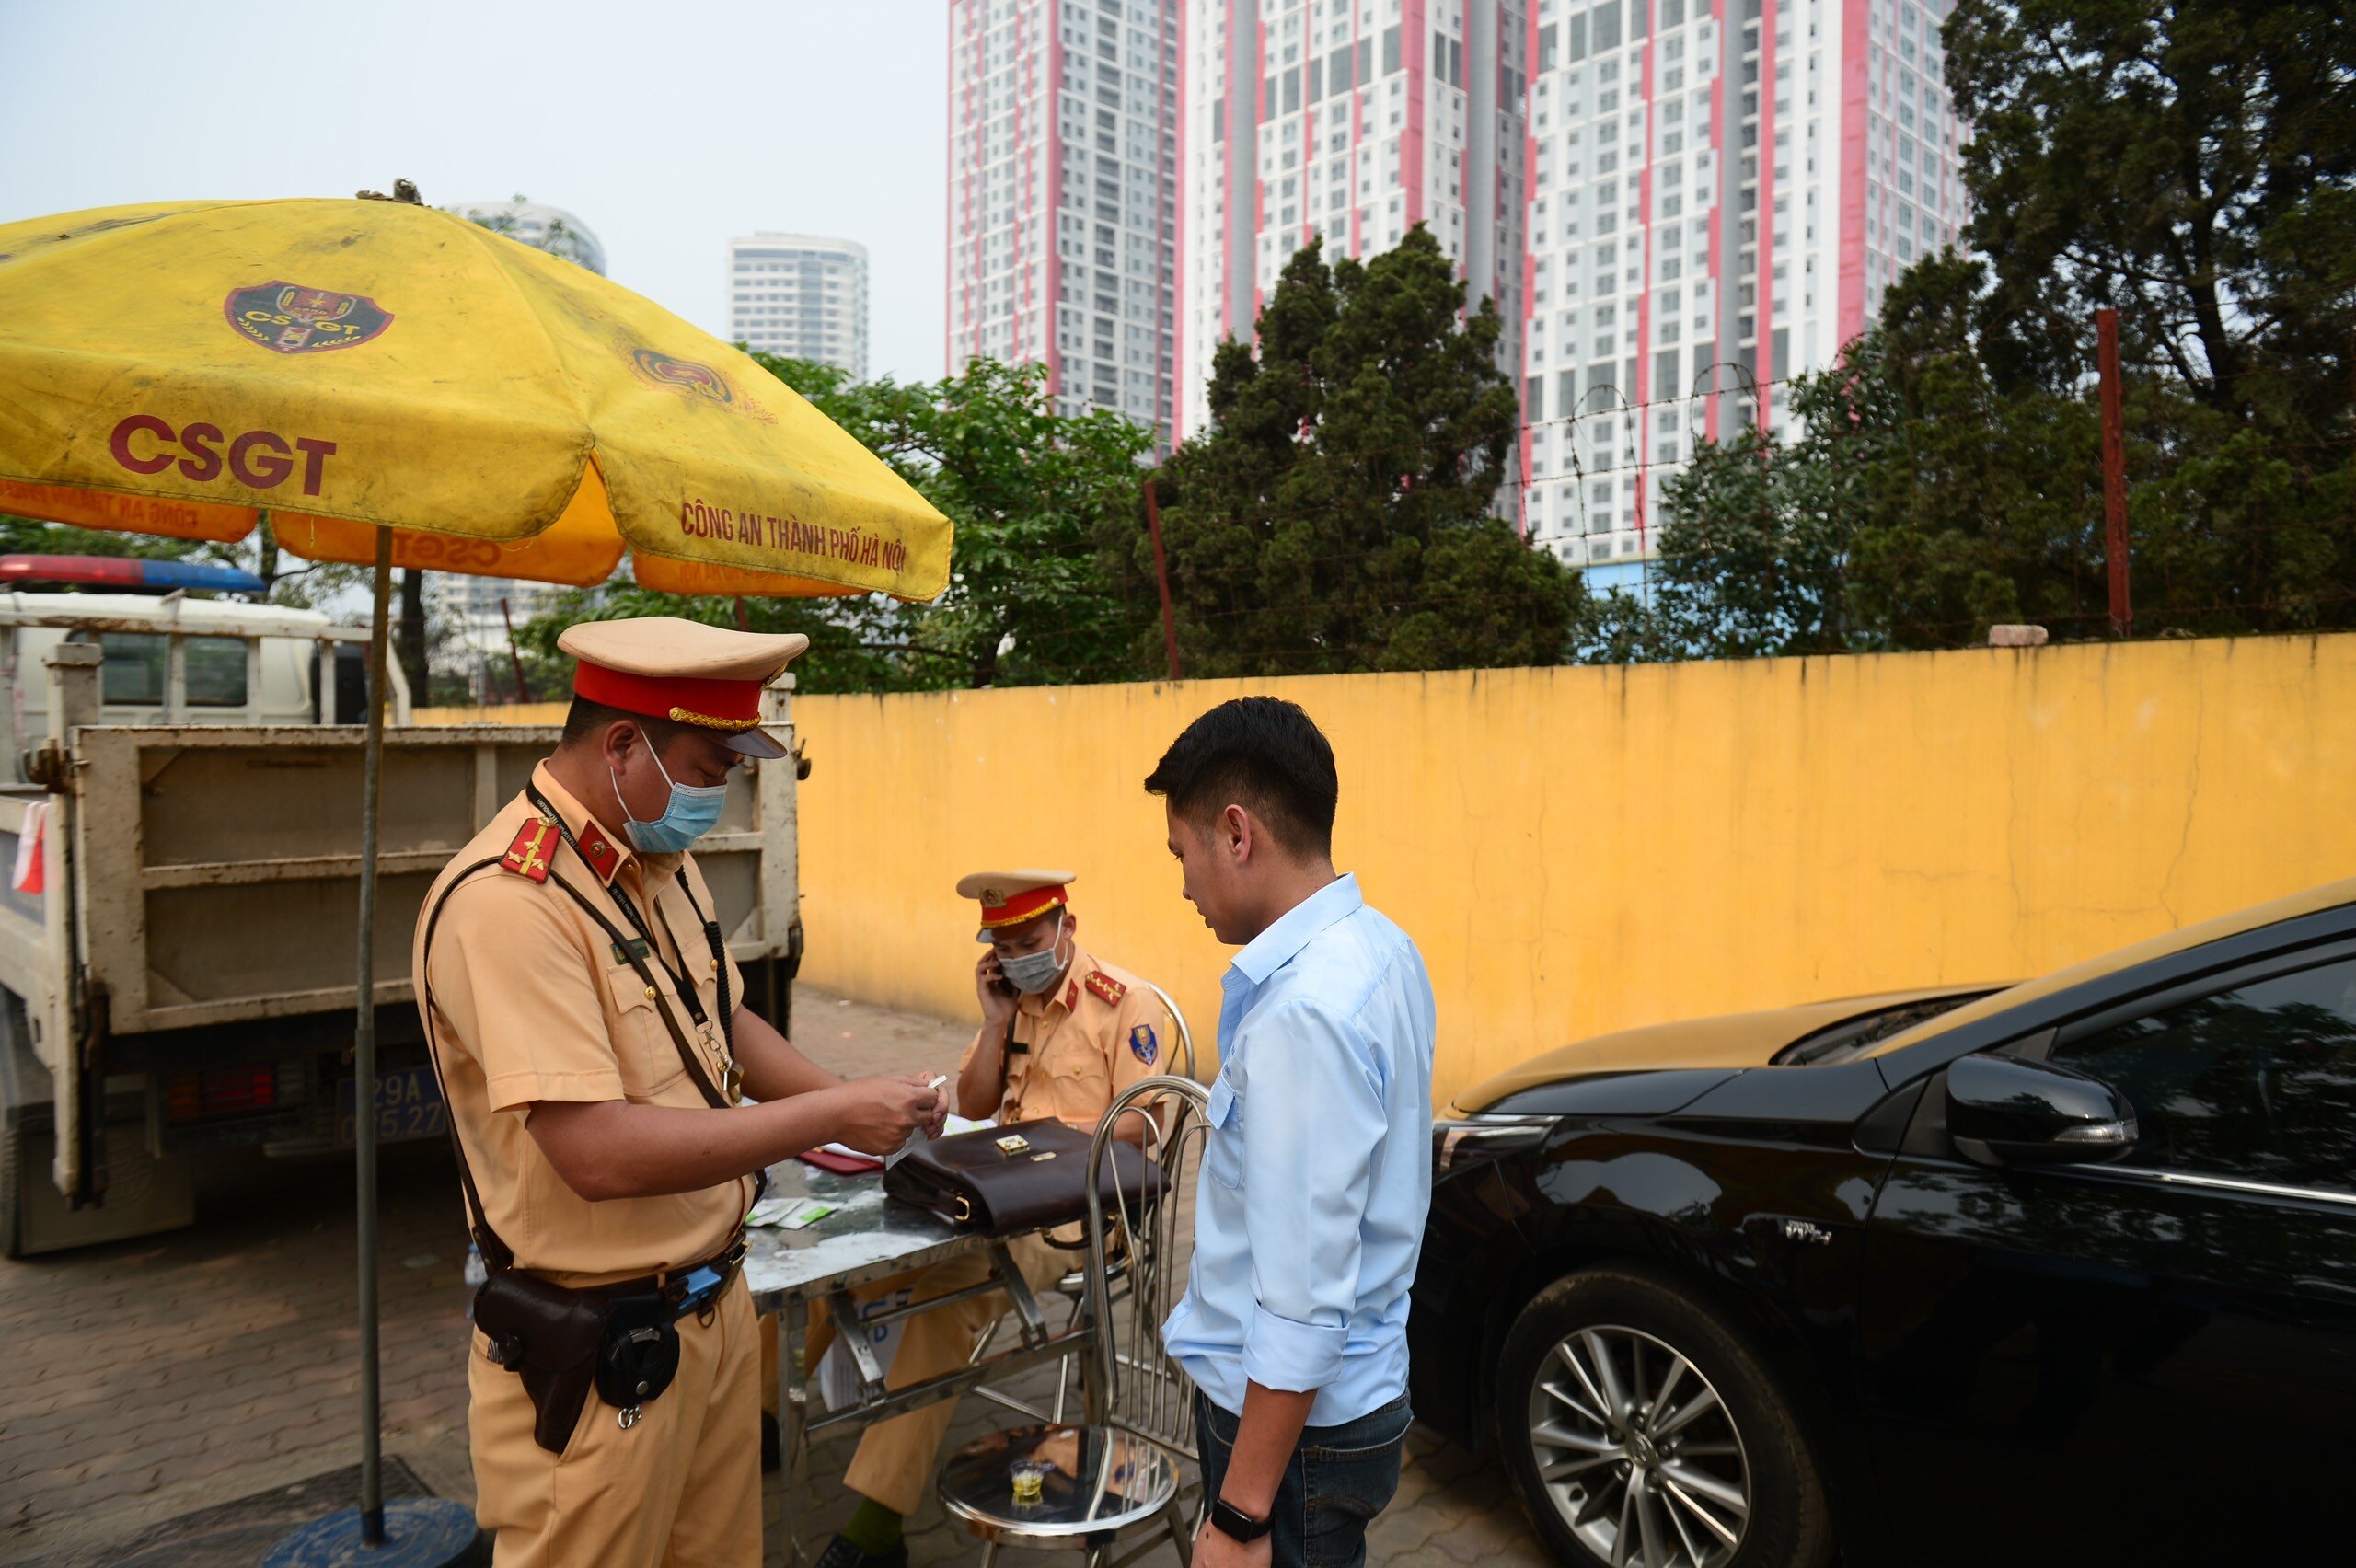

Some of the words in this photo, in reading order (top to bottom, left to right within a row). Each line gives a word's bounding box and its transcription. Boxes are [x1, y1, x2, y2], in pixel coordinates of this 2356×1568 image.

[245, 310, 292, 325] CS
[314, 321, 360, 335] GT
[110, 414, 337, 496] CSGT
[682, 498, 733, 541] CÔNG
[739, 512, 762, 546] AN
[767, 515, 826, 556] THÀNH
[829, 525, 860, 562] PHỐ
[860, 533, 879, 568] HÀ
[341, 1101, 443, 1145] 05.27
